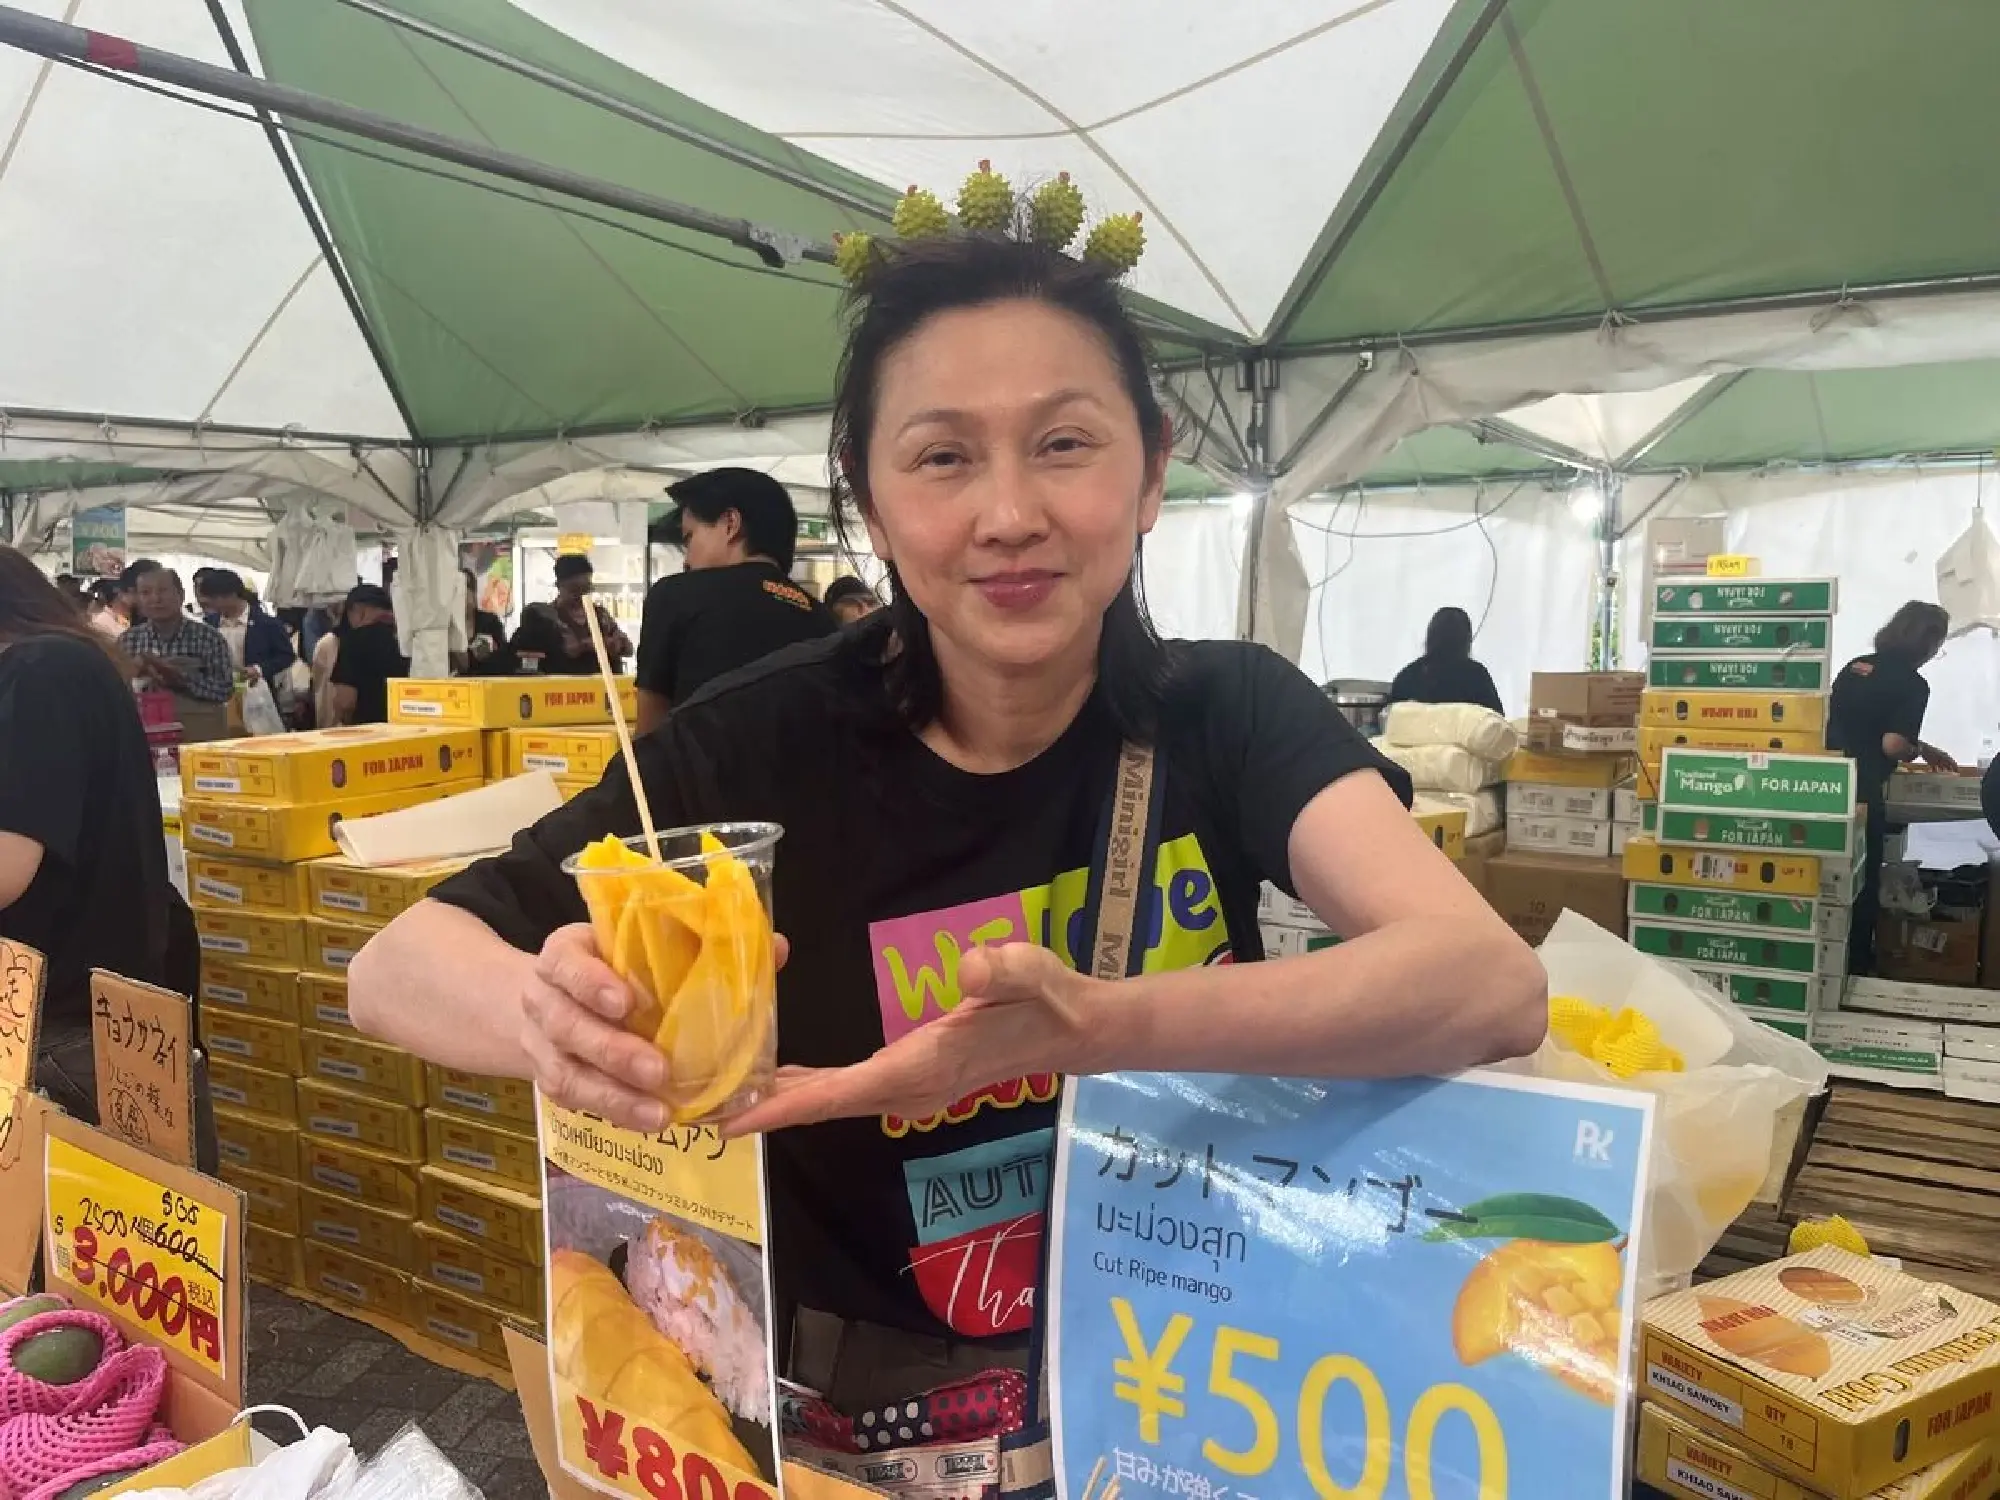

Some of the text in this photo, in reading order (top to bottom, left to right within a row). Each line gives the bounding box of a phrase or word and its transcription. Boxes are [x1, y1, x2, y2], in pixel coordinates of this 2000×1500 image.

[1680, 777, 1733, 796] Mango
[1761, 777, 1842, 795] FOR JAPAN
[1721, 829, 1784, 846] FOR JAPAN
[921, 1152, 1052, 1229] AUT
[1093, 1251, 1233, 1304] Cut Ripe mango
[1661, 1350, 1703, 1381] VARIETY
[1652, 1371, 1685, 1393] KHIAO
[1111, 1297, 1510, 1500] ¥500
[576, 1394, 773, 1500] ¥80
[1677, 1468, 1714, 1492] KHIAO
